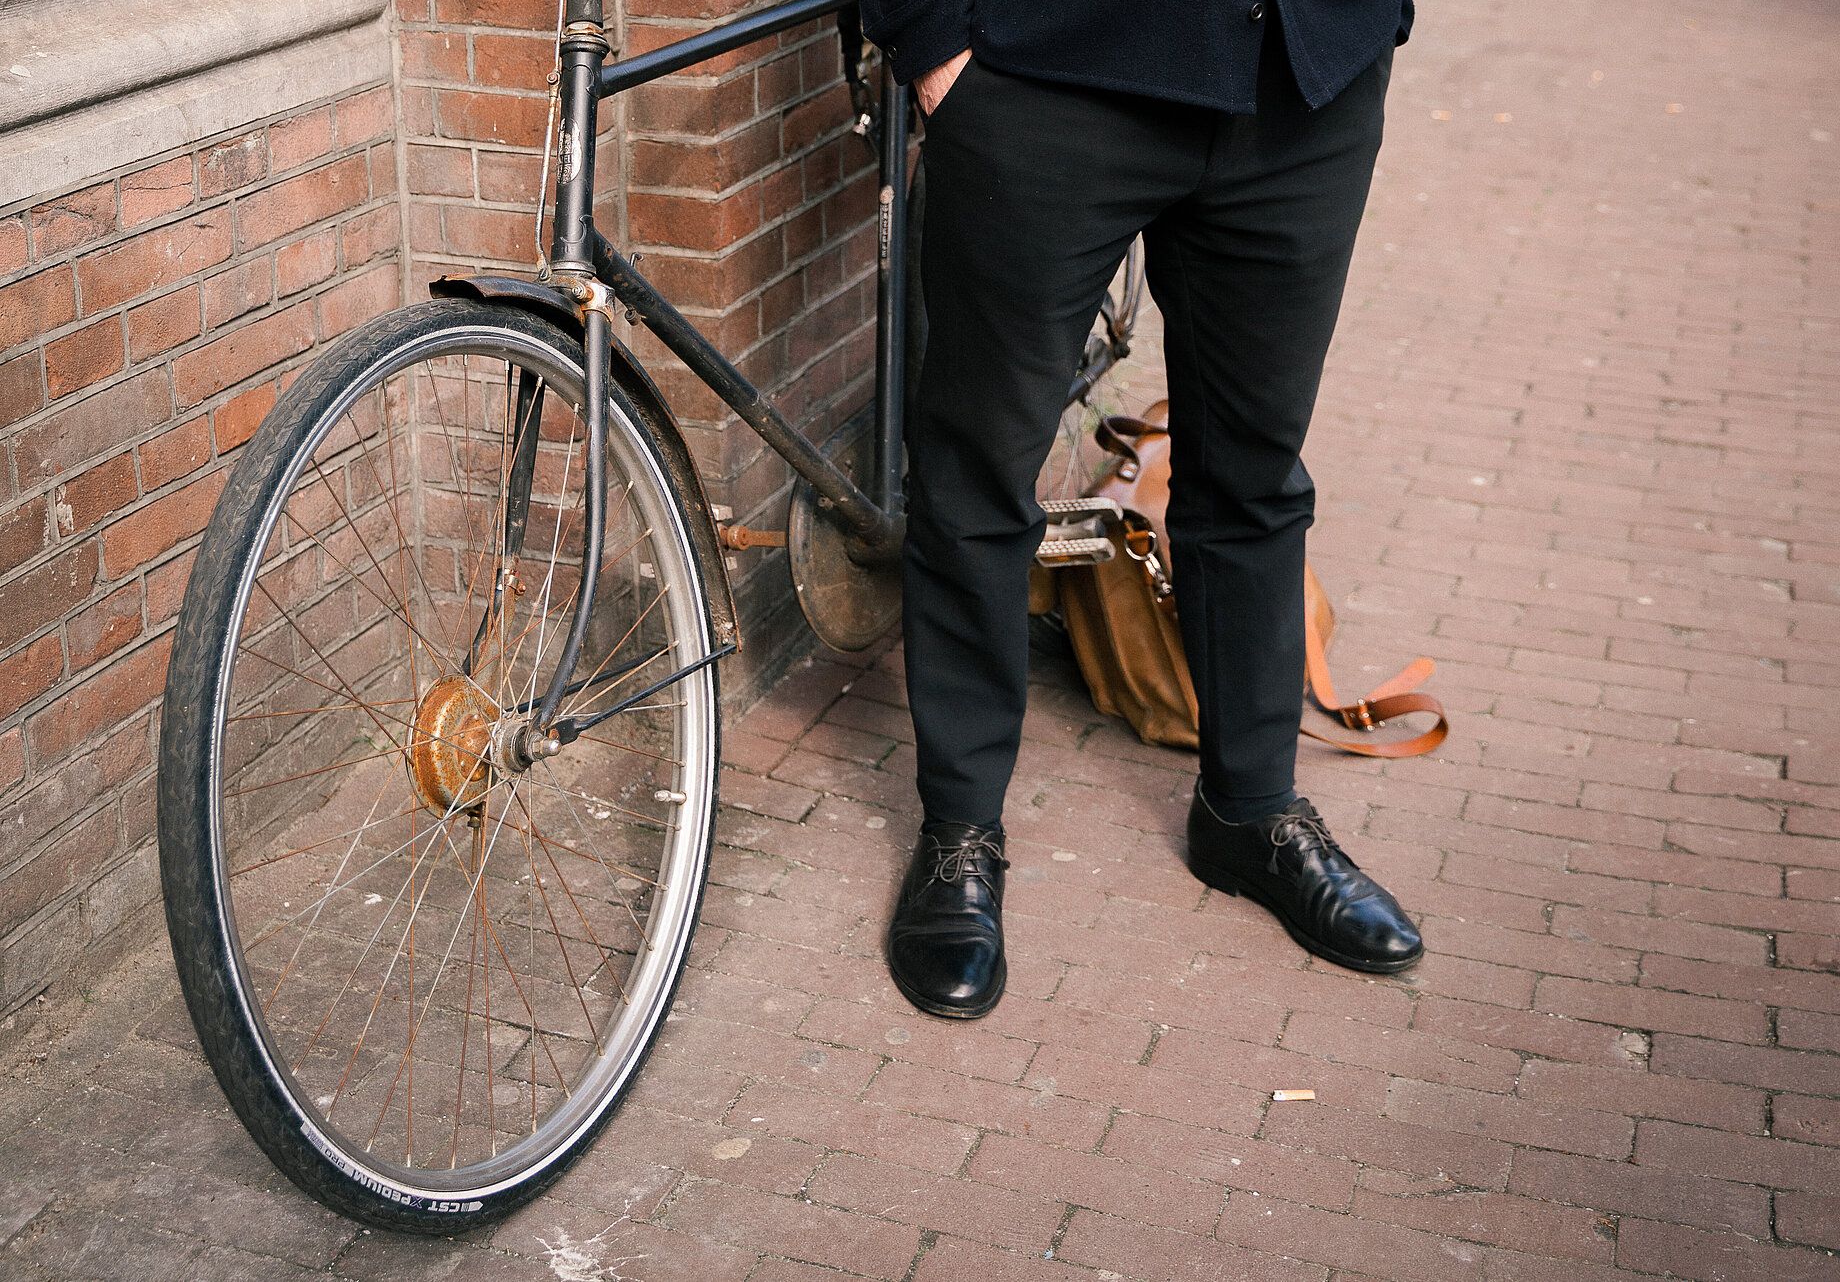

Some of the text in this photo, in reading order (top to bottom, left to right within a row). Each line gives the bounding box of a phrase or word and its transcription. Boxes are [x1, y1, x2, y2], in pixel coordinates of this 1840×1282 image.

[324, 1149, 462, 1212] CST XPEDIUM PRO
